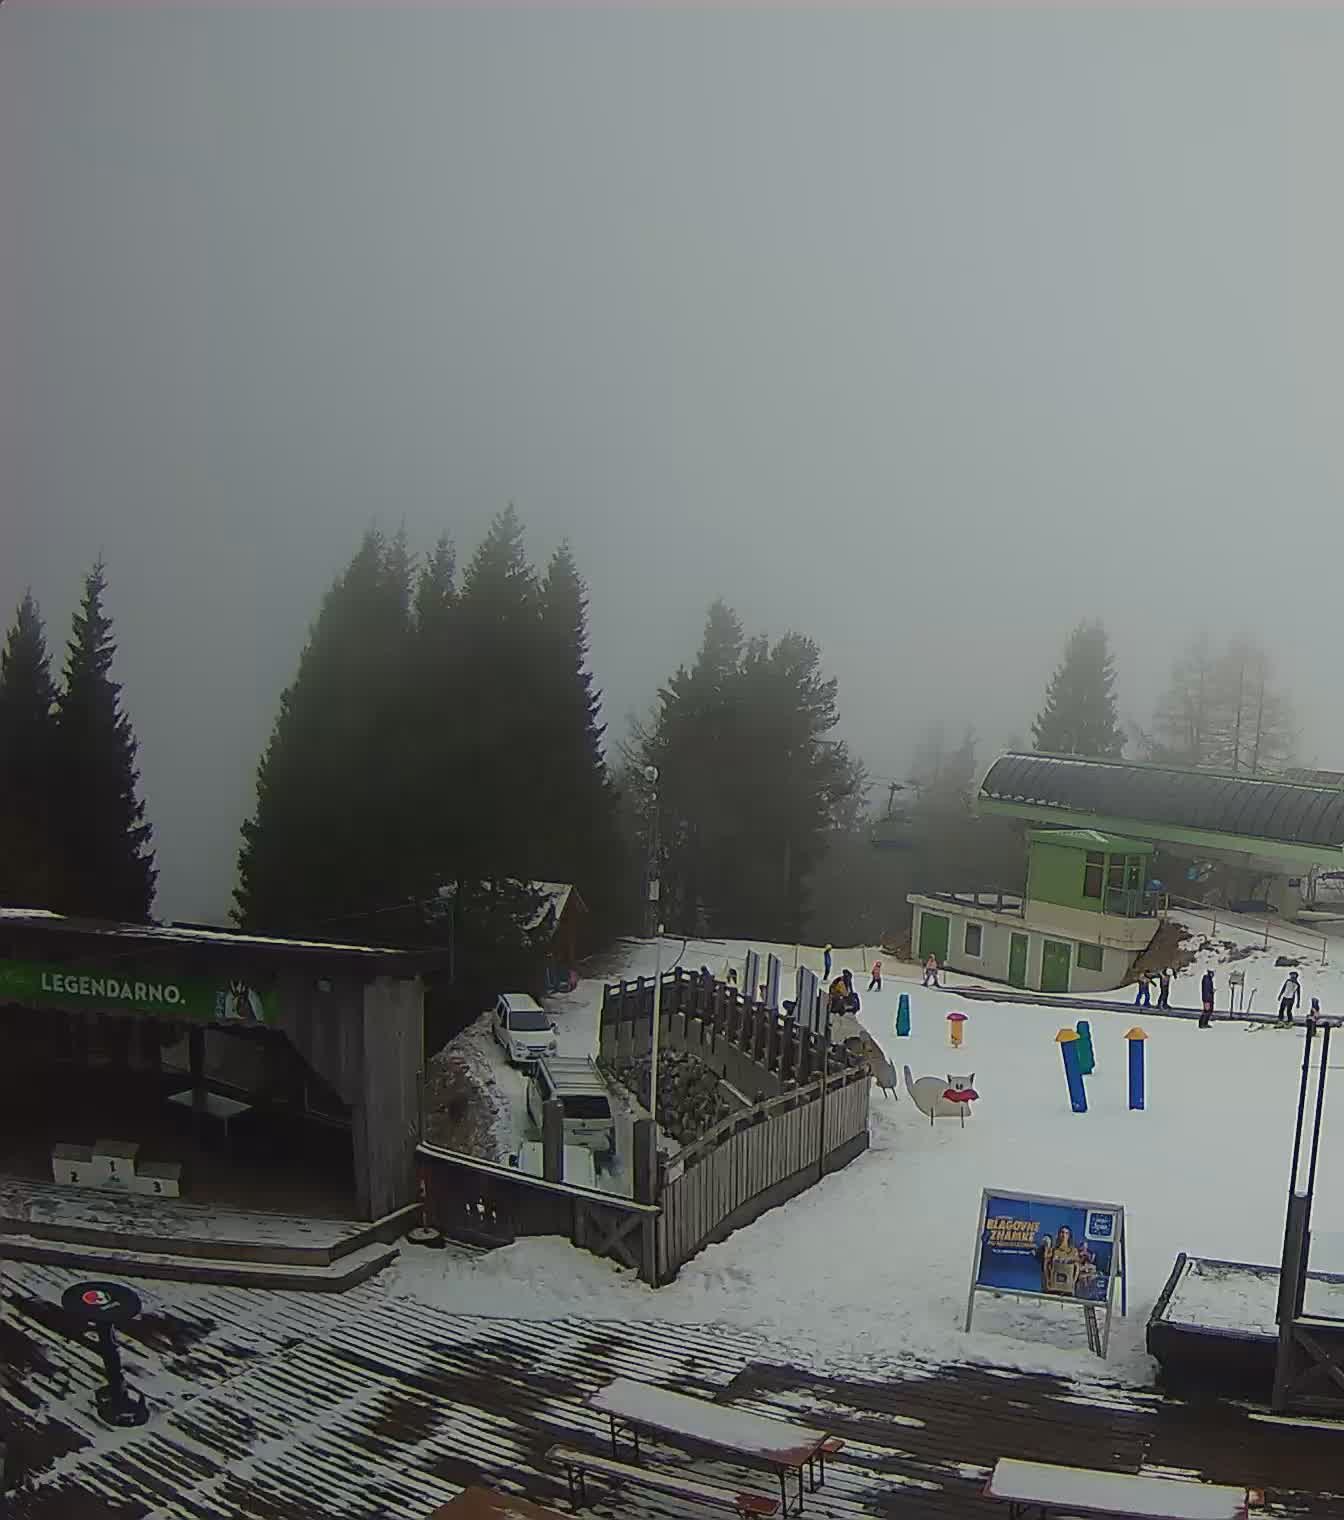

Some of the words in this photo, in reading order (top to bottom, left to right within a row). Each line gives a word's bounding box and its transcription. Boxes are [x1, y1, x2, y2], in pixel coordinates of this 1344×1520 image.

[41, 972, 186, 1004] LEGENDARNO.
[70, 1171, 79, 1182] 2
[991, 1230, 1035, 1241] ZNAMKE
